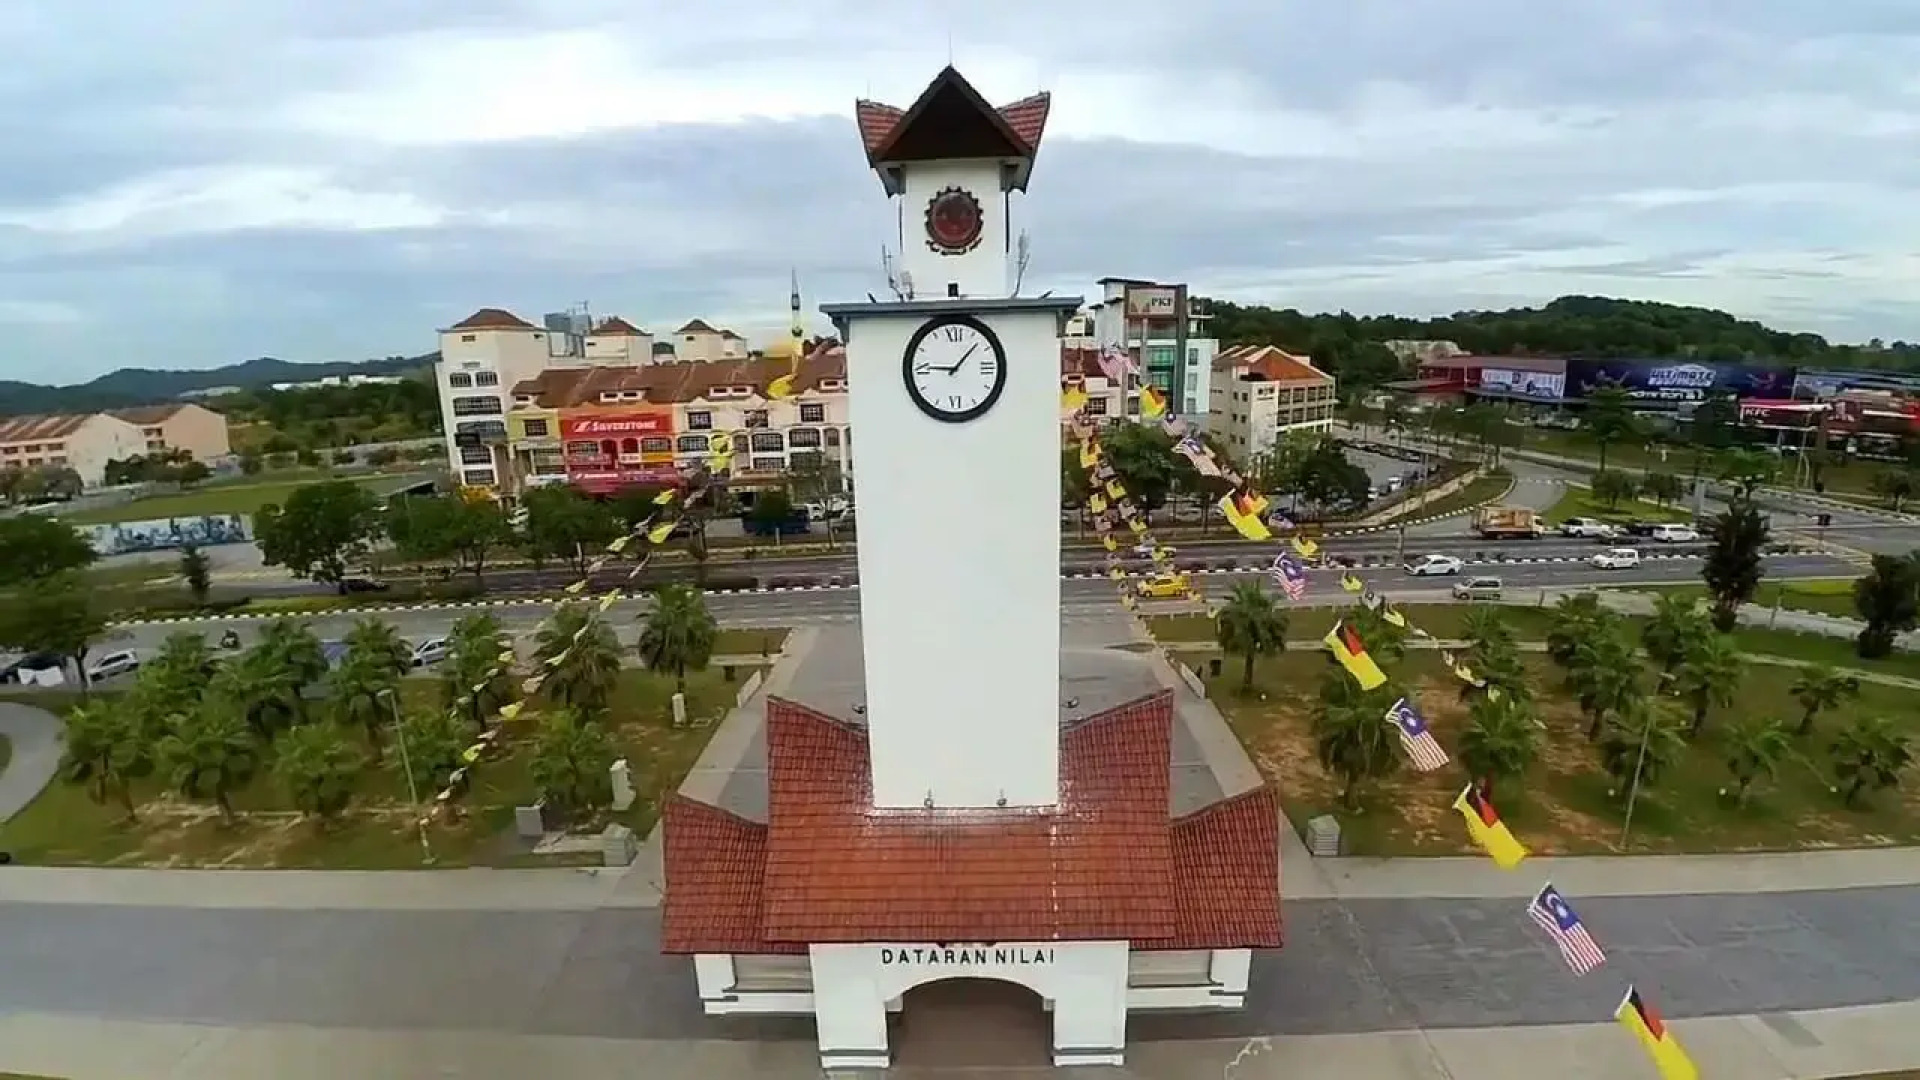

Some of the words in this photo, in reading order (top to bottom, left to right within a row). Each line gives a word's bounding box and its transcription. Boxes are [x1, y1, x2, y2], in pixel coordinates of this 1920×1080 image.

[945, 327, 963, 342] XII
[949, 395, 961, 408] VI
[1745, 408, 1770, 417] KFC
[881, 948, 987, 964] DATARAN
[995, 948, 1055, 964] NILAI
